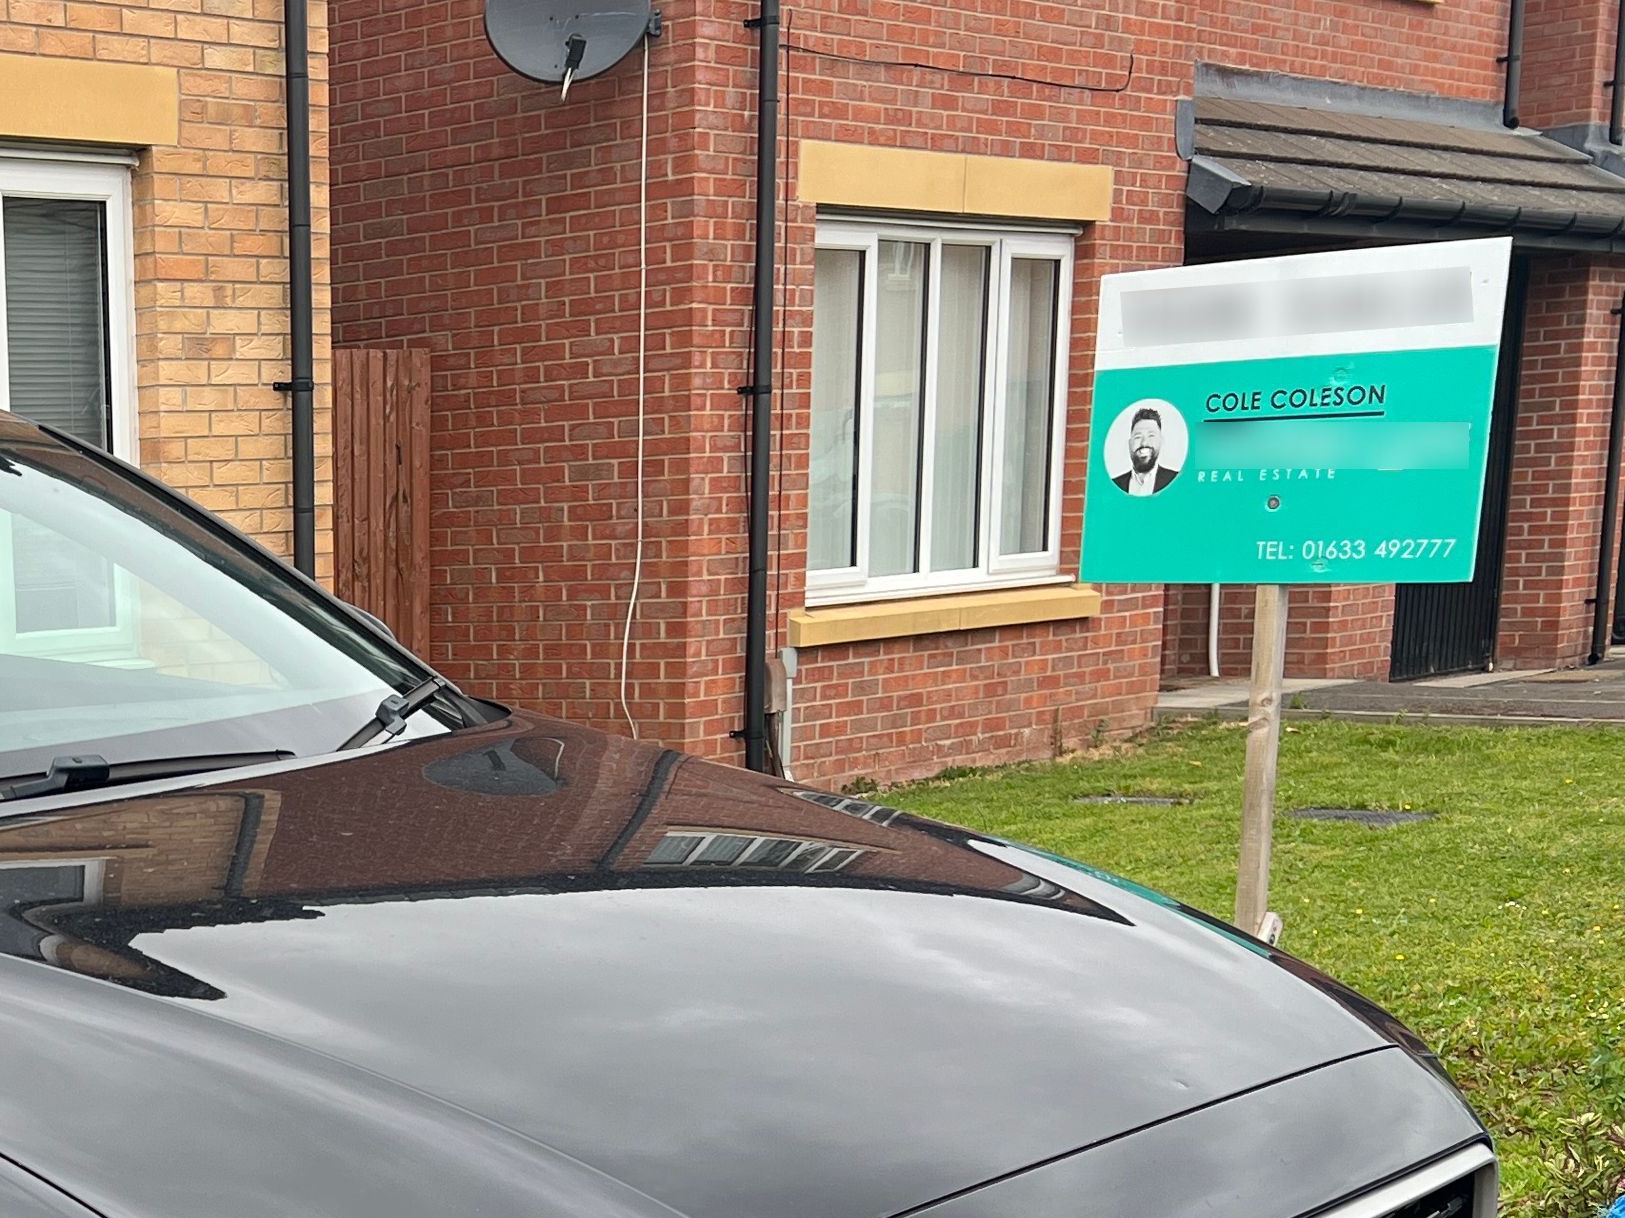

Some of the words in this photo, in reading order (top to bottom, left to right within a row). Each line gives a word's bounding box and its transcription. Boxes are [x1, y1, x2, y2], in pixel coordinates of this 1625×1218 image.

[1206, 391, 1261, 413] COLE
[1271, 384, 1385, 409] COLESON
[1198, 469, 1244, 482] REAL
[1259, 468, 1336, 481] ESTATE
[1256, 540, 1294, 560] TEL:
[1302, 539, 1366, 560] 01633
[1374, 538, 1456, 559] 492777
